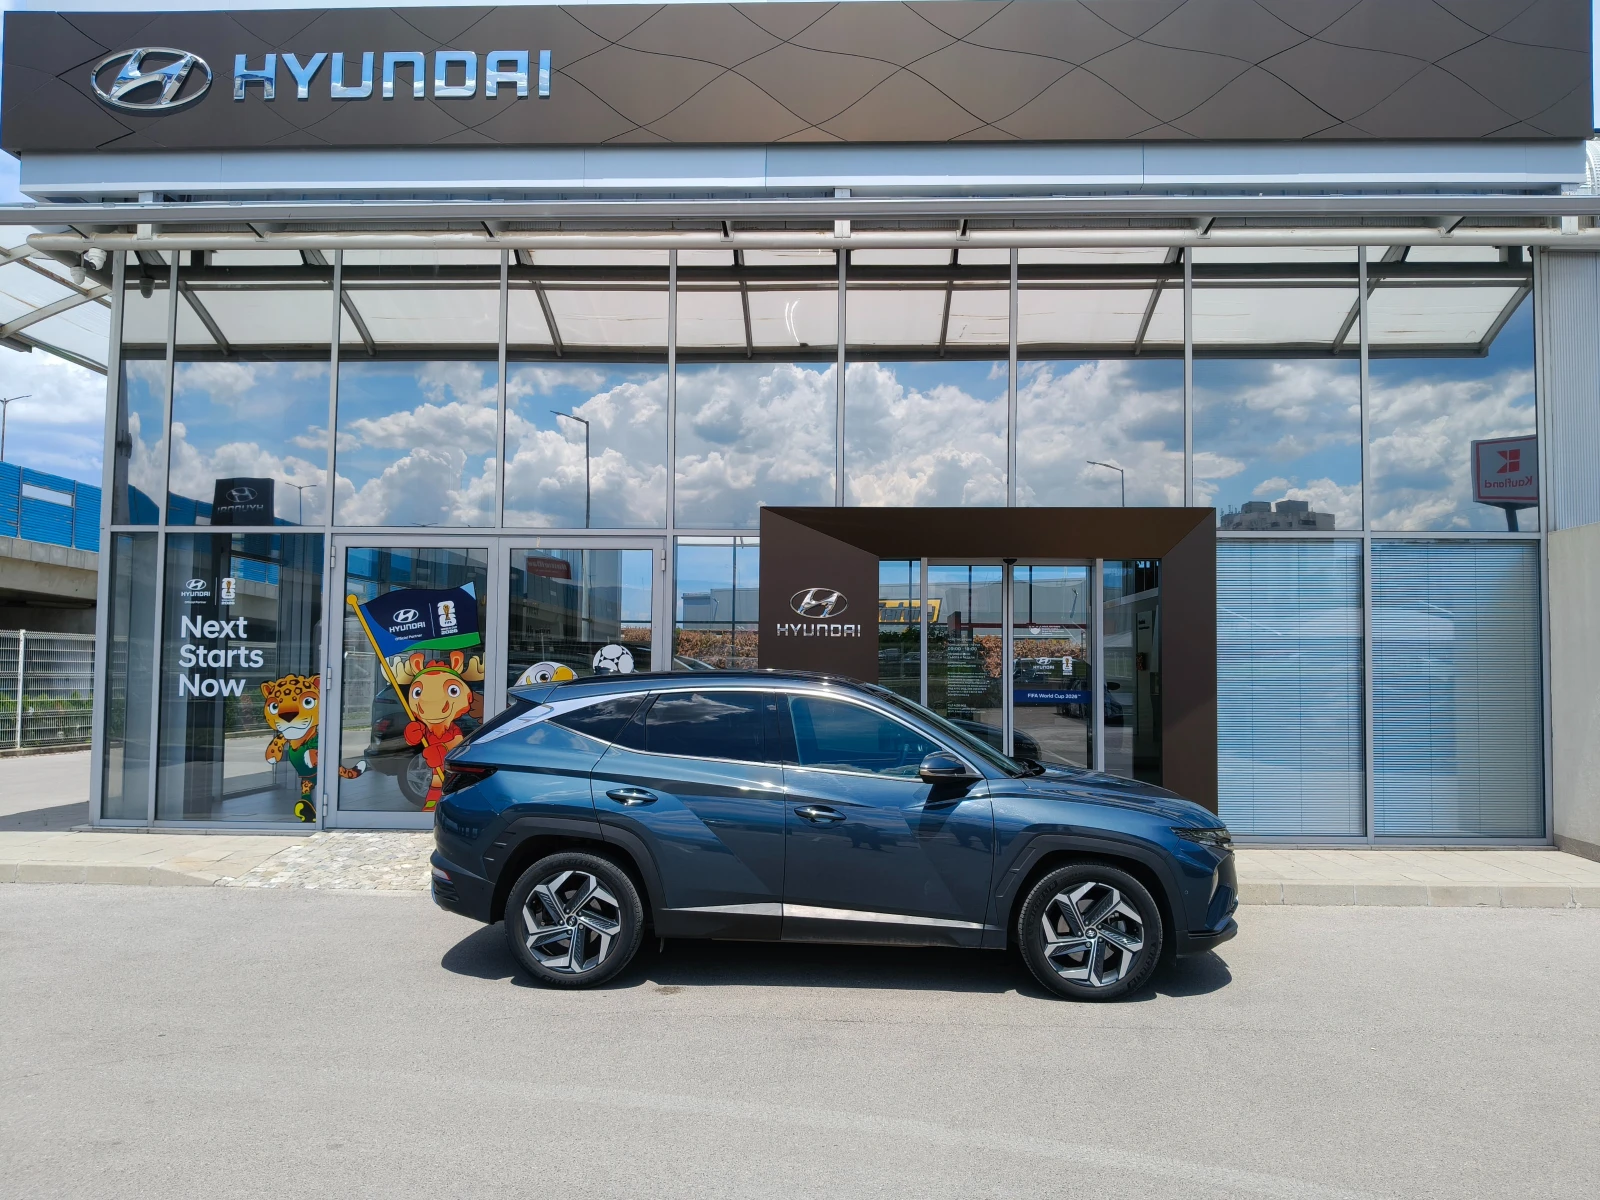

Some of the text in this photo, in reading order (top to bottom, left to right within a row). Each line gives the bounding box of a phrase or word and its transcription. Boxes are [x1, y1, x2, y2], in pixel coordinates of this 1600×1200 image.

[233, 50, 551, 100] HYUNDAI
[180, 615, 248, 639] Next
[389, 621, 426, 633] HYUNDAI
[776, 623, 861, 637] HYUNDAI
[178, 644, 264, 668] Starts
[178, 673, 247, 697] Now
